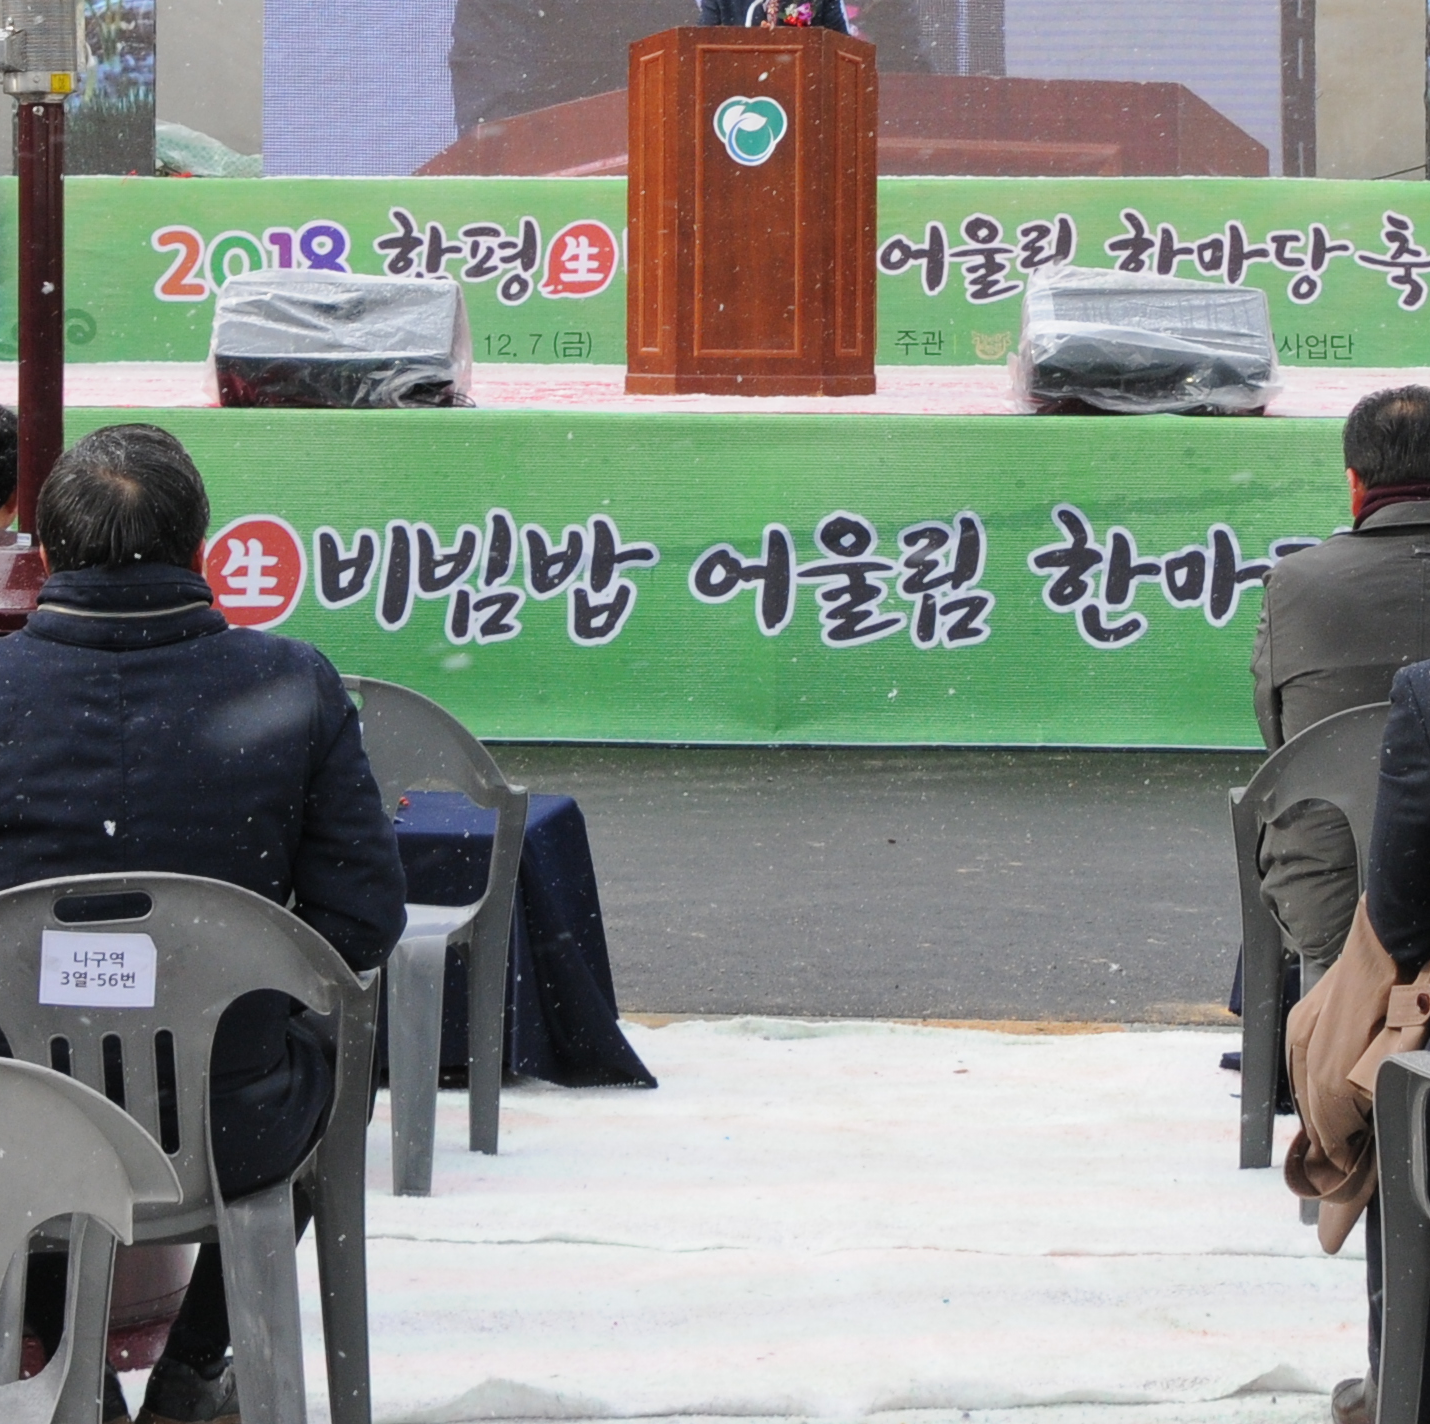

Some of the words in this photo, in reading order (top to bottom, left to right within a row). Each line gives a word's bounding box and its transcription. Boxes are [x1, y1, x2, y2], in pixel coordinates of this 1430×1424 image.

[155, 223, 349, 297] 2018
[894, 330, 945, 356] 주관
[1271, 333, 1355, 360] 사업단
[694, 515, 989, 643] 어울림
[1034, 509, 1322, 642] 한마
[73, 951, 125, 969] 나구역
[60, 971, 136, 988] 3열-56번
